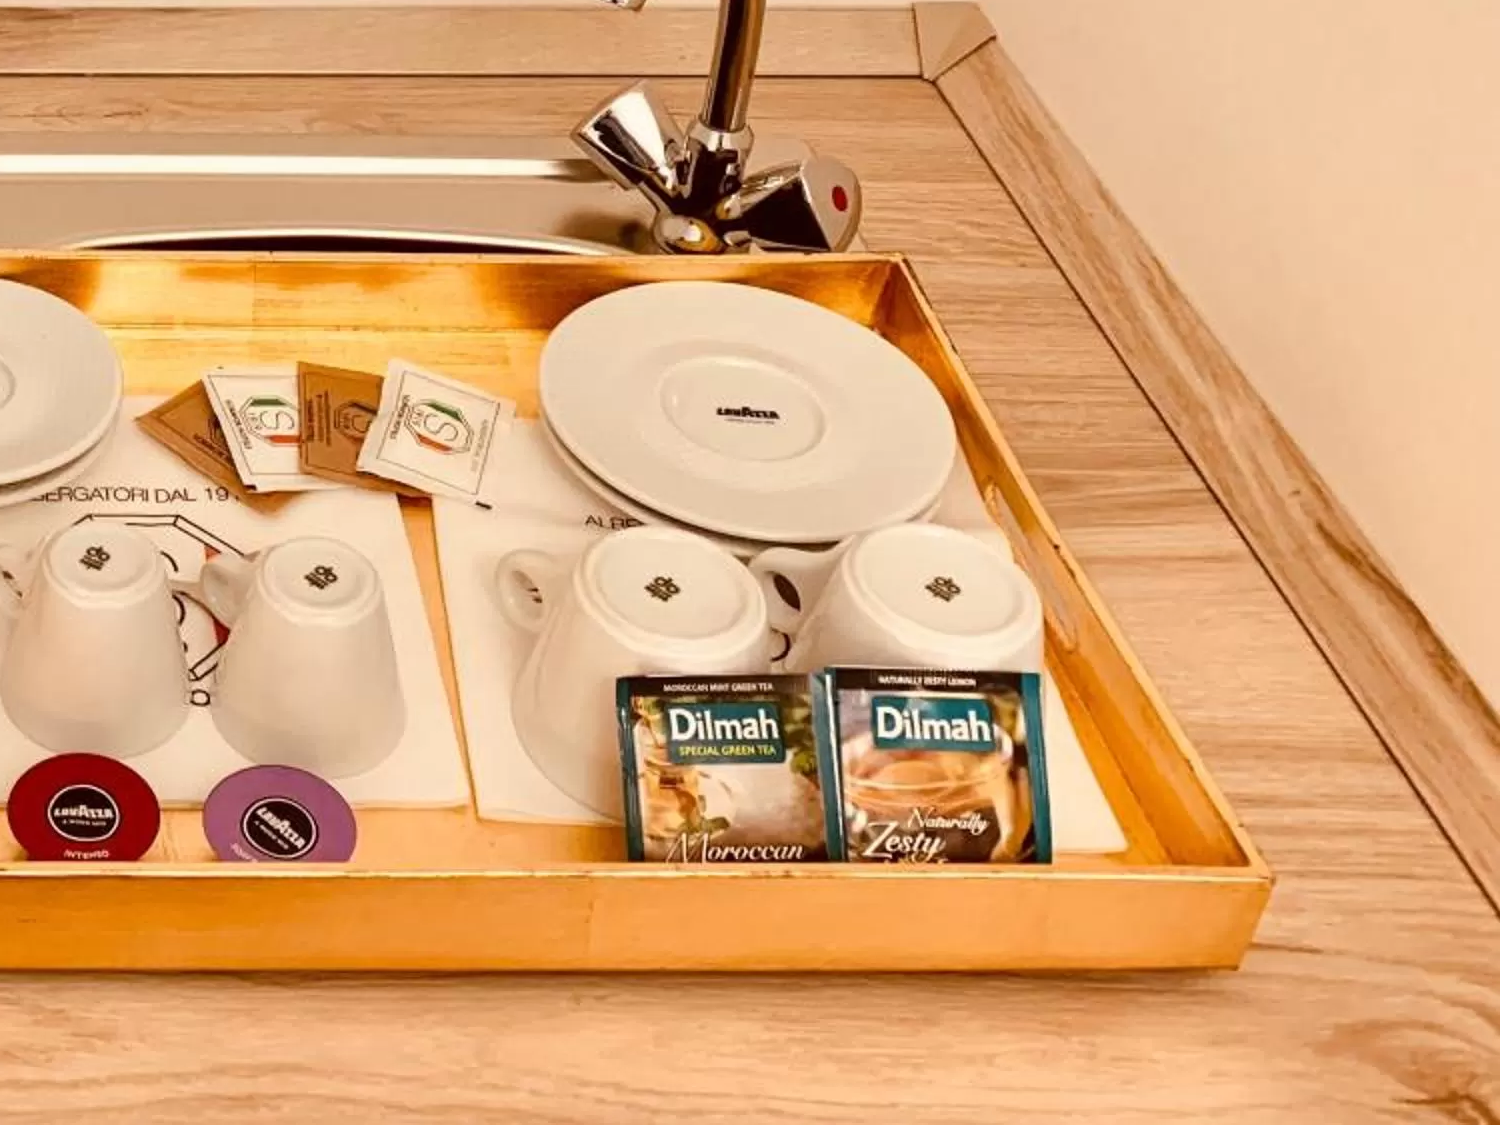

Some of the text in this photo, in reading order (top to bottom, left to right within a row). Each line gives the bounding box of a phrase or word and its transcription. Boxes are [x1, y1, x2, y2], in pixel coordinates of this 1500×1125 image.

[155, 488, 196, 504] DAL
[204, 486, 239, 503] 19
[758, 682, 774, 692] TEA
[668, 707, 779, 742] Dilmah
[874, 706, 993, 743] Dilmah
[678, 745, 777, 757] SPECIAL GREEN TEA
[53, 804, 114, 819] LAVAZZA
[907, 807, 990, 837] Naturally
[255, 807, 306, 850] LAVAZZA
[862, 821, 948, 863] Zesty
[664, 832, 804, 864] Moroccan
